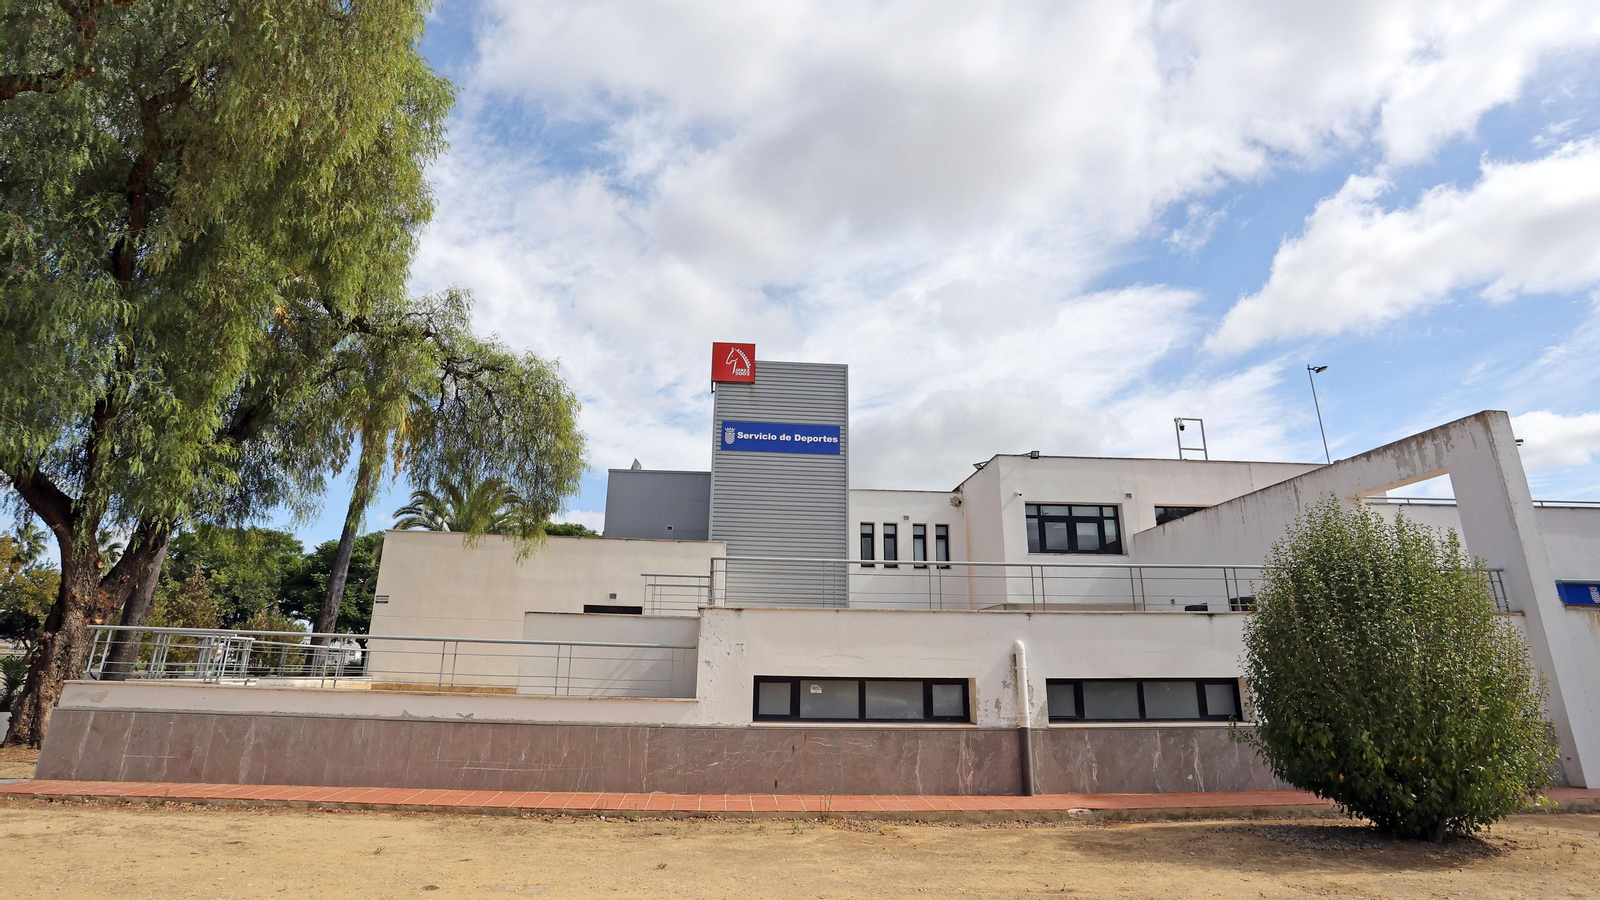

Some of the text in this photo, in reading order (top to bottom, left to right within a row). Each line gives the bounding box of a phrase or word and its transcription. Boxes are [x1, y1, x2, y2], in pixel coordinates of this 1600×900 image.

[737, 431, 838, 443] Servicio de Deportes
